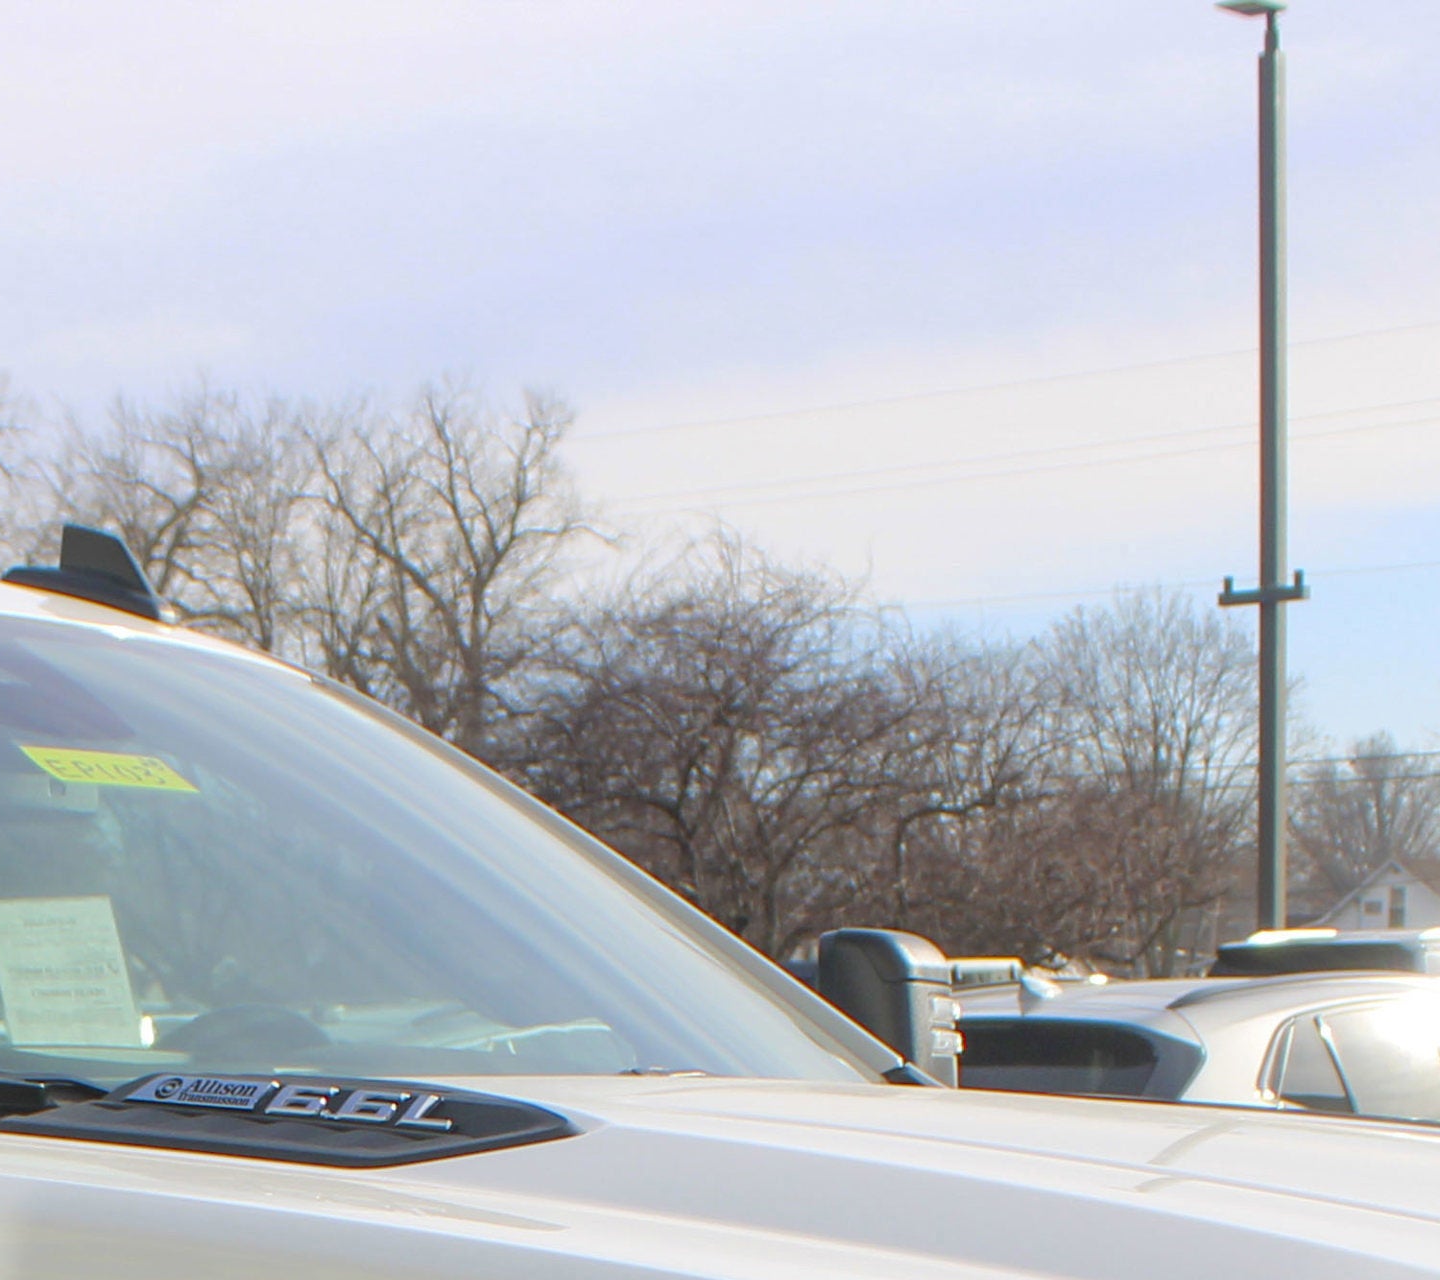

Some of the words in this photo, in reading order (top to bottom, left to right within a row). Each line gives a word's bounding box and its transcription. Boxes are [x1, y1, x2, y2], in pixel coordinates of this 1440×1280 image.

[186, 1078, 258, 1098] Allison
[176, 1091, 251, 1107] Transmission
[265, 1083, 453, 1131] 6.6L
